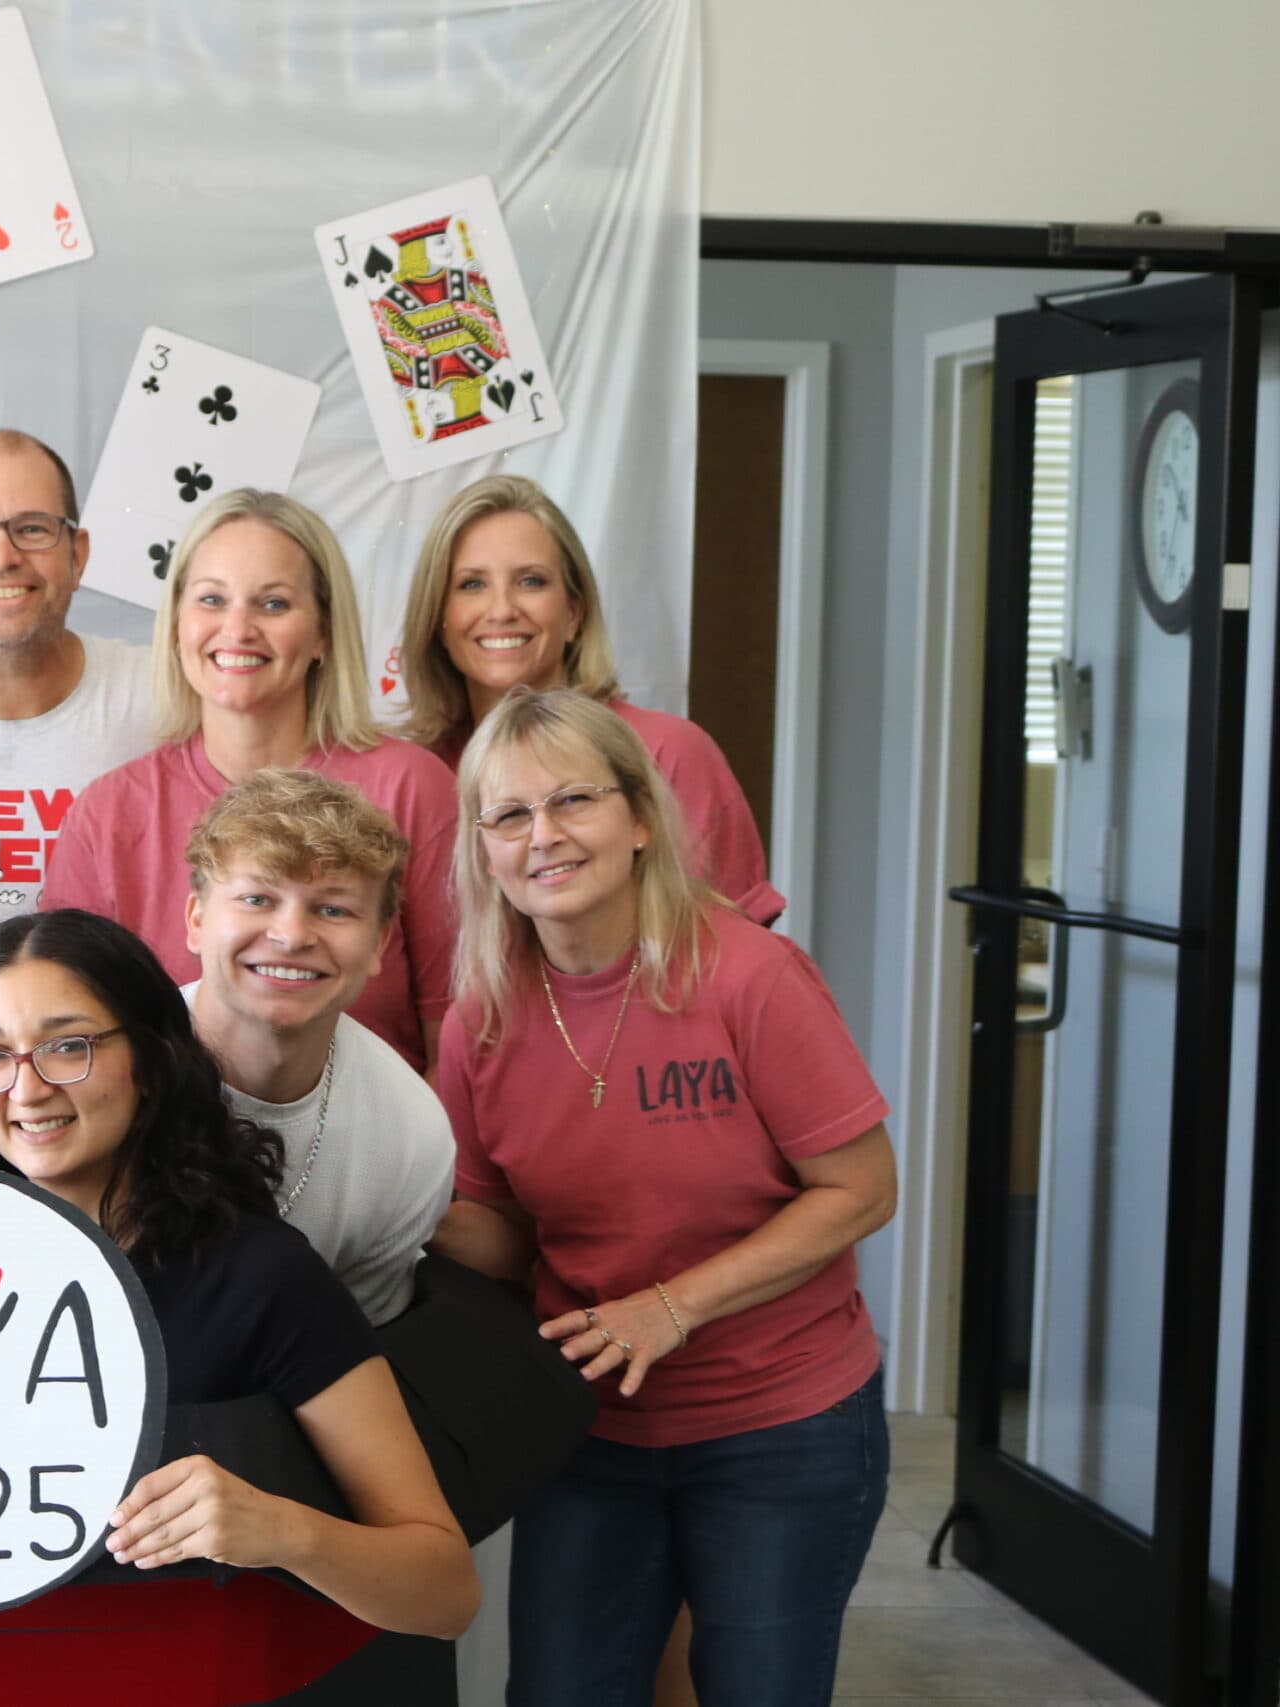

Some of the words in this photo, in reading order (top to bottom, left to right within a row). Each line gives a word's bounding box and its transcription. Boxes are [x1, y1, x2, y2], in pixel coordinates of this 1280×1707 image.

[56, 220, 79, 250] 2
[334, 235, 349, 266] J
[150, 343, 171, 371] 3
[530, 391, 544, 422] J
[636, 1057, 737, 1112] LAYA
